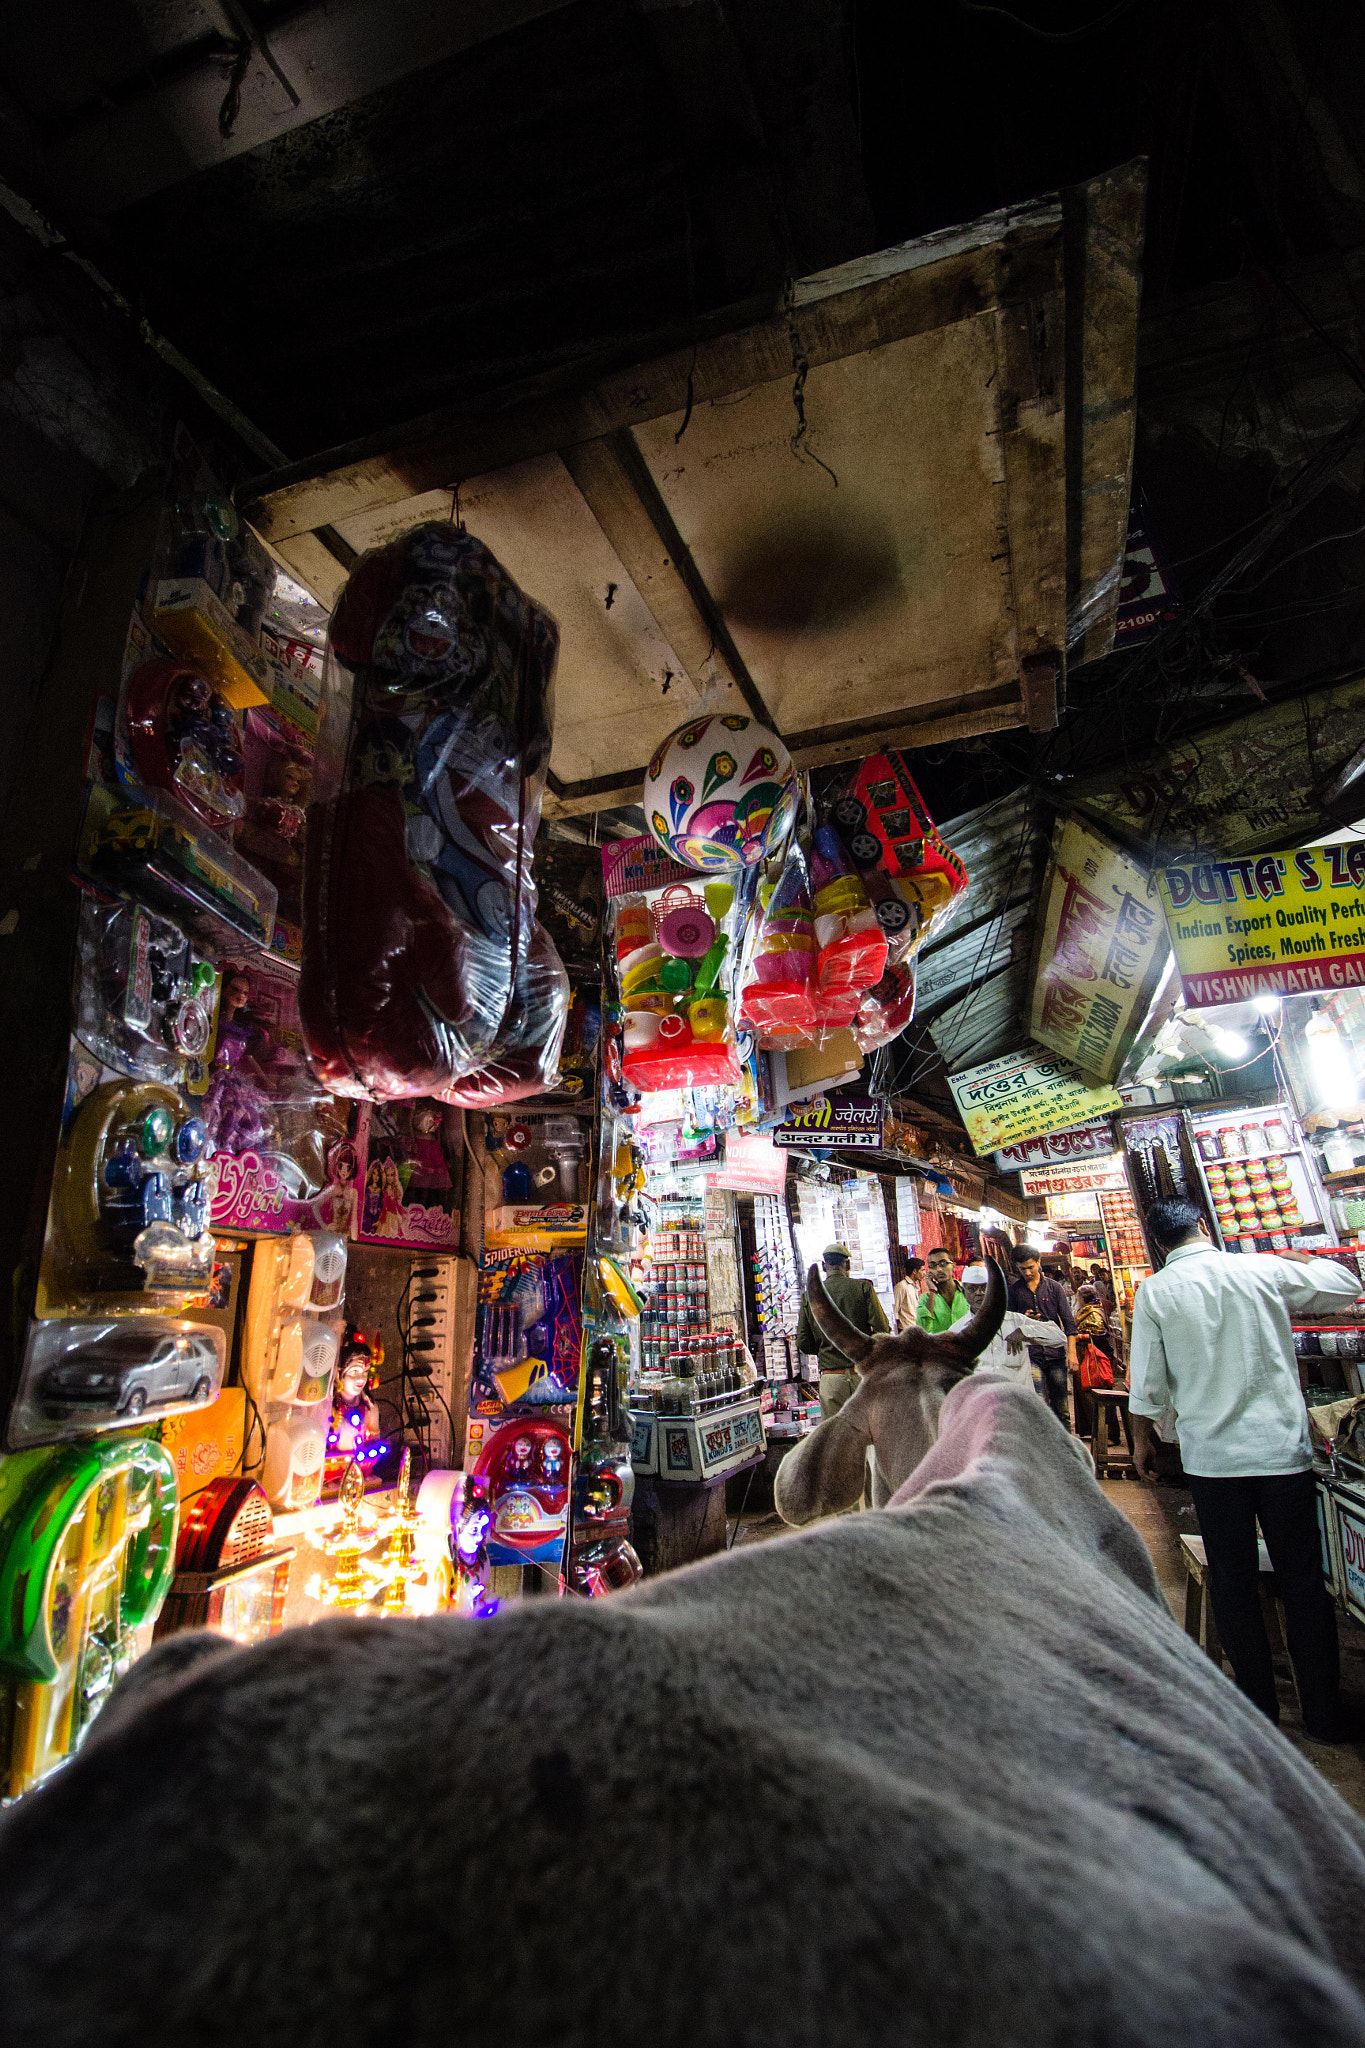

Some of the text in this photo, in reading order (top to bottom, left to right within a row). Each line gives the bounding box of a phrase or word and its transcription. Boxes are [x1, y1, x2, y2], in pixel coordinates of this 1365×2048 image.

[1176, 919, 1222, 940] Indian
[1225, 913, 1272, 937] Export
[1276, 905, 1327, 927] Quality
[1227, 944, 1276, 966] Spices,
[1280, 937, 1326, 956] Mouth
[1188, 966, 1324, 1003] VISHWANATH
[1085, 993, 1123, 1040] ZARDA
[951, 1073, 969, 1084] Estd.
[835, 1102, 881, 1124] ज्वेलरी
[726, 1146, 746, 1159] NDU
[780, 1133, 875, 1144] अन्दर गली में
[236, 1185, 284, 1220] girl
